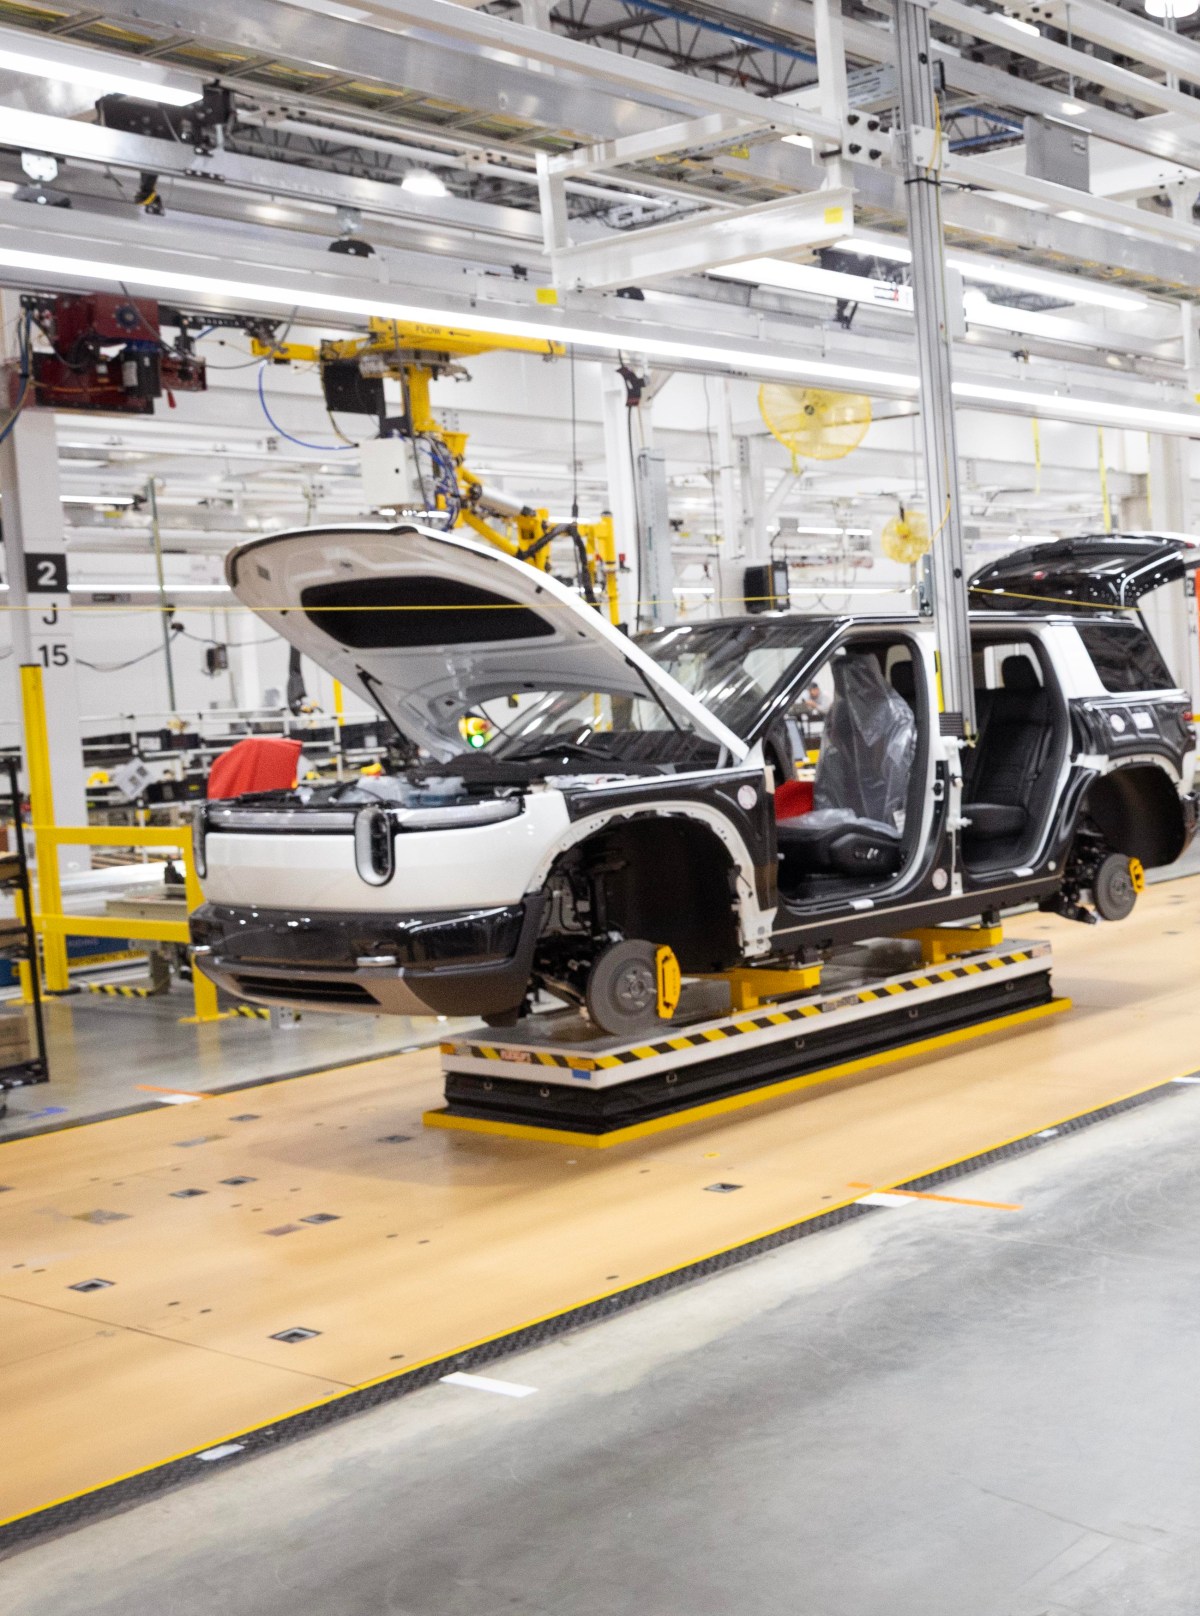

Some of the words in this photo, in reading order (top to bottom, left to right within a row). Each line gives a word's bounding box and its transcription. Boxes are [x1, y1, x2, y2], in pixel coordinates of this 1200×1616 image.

[37, 561, 58, 586] 2
[42, 602, 57, 626] J
[38, 644, 69, 668] 15
